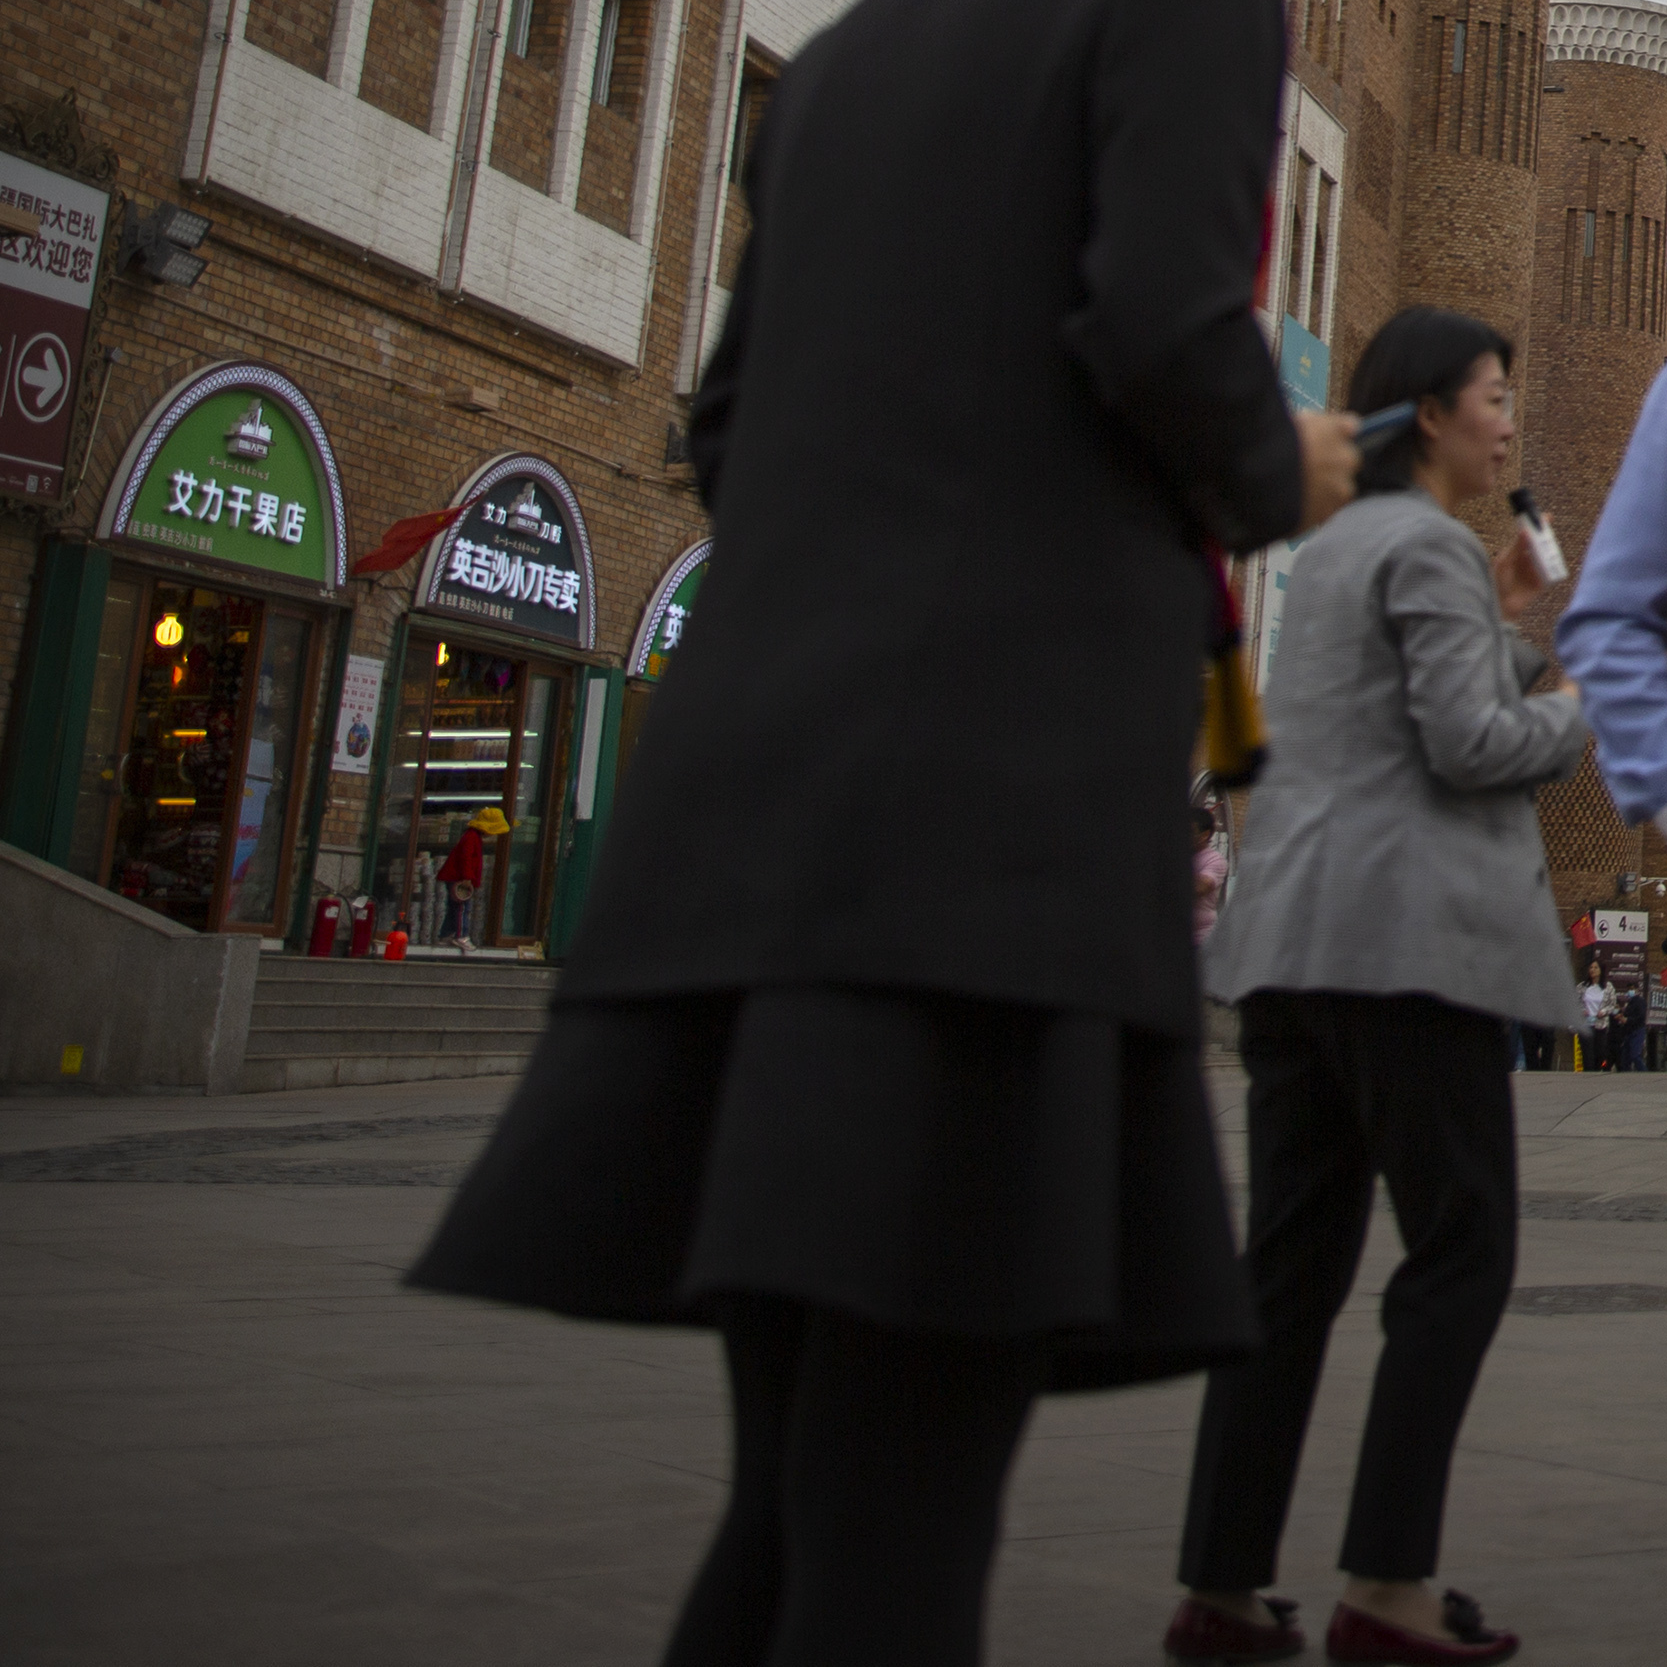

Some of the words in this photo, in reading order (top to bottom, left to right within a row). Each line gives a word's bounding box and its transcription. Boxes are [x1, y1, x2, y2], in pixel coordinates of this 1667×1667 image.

[168, 469, 307, 544] 艾力干果店
[483, 502, 507, 525] 艾力
[448, 538, 581, 614] 英吉沙小刀专卖
